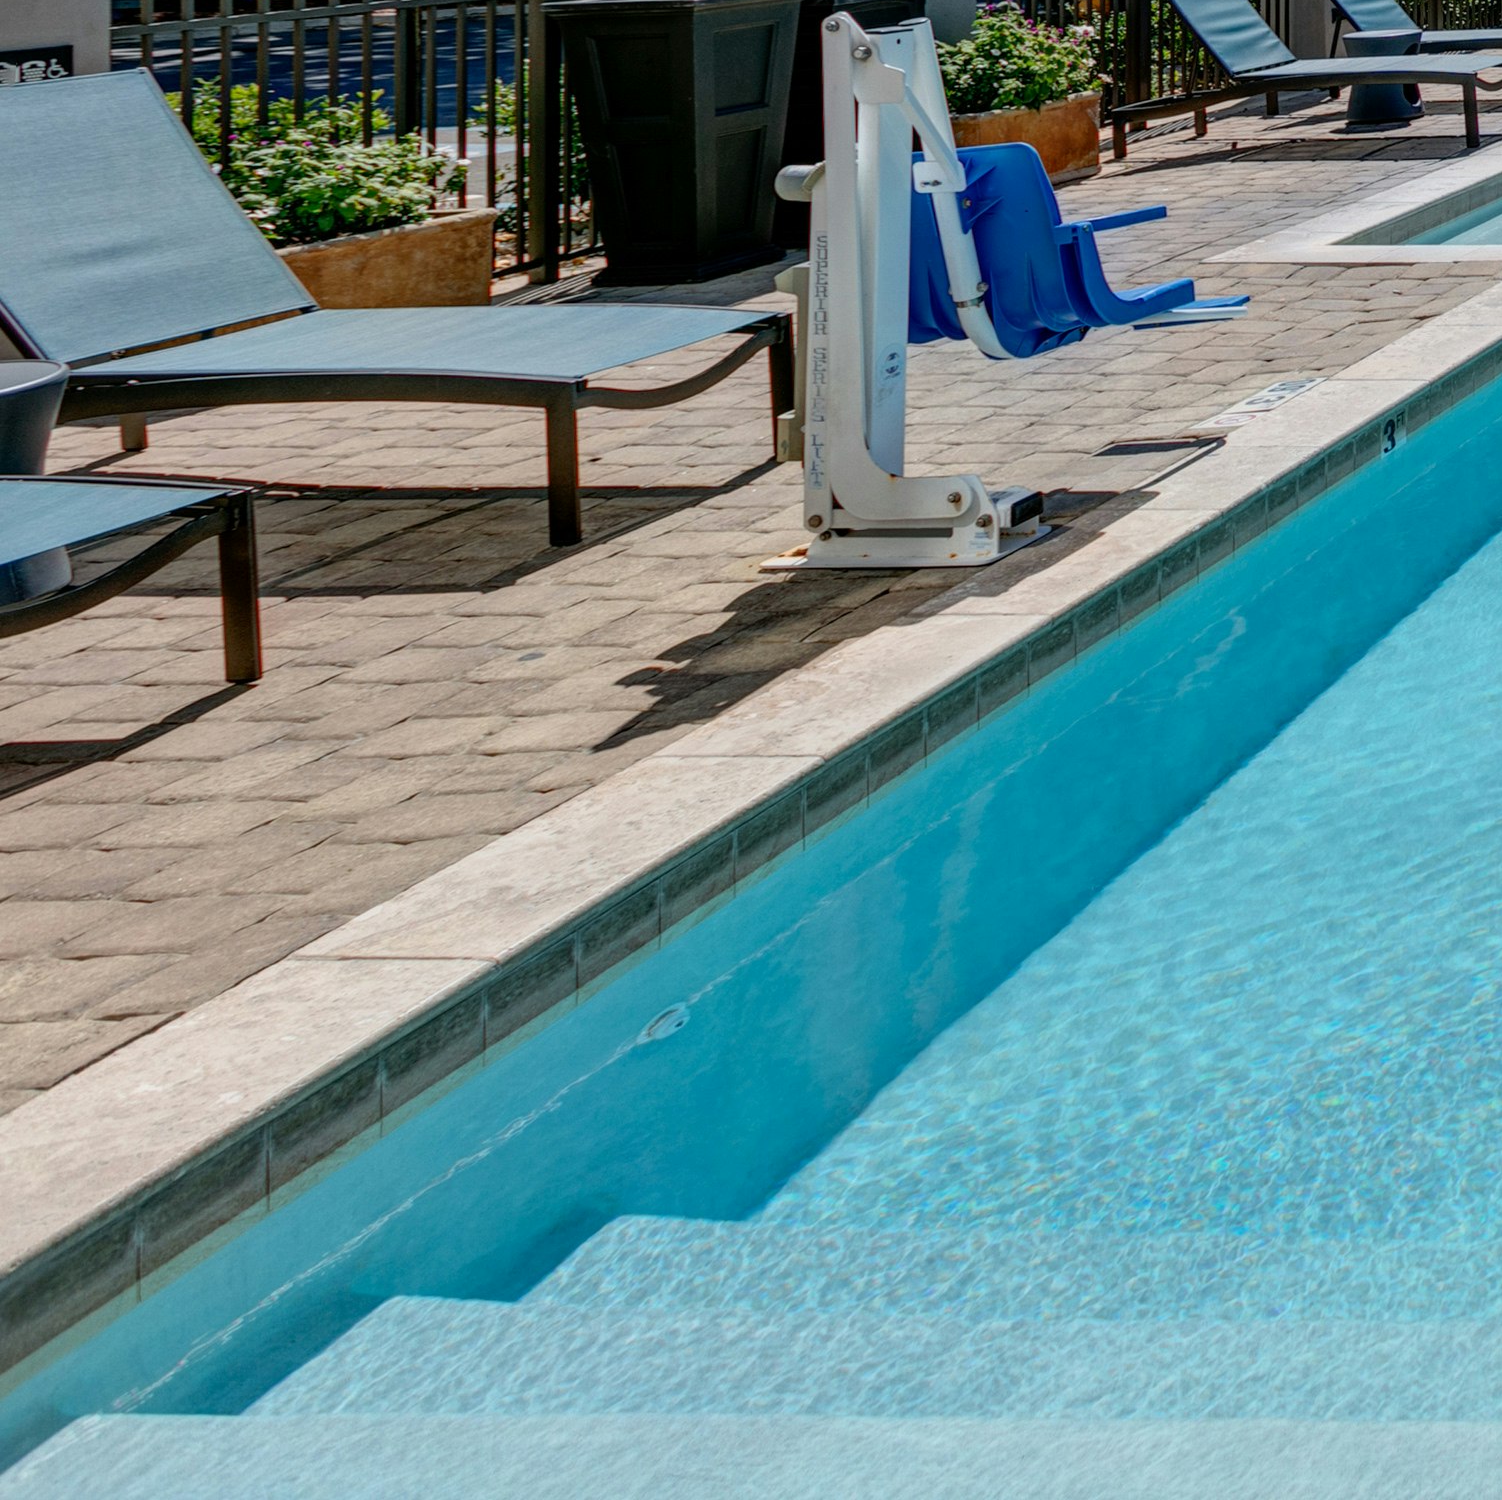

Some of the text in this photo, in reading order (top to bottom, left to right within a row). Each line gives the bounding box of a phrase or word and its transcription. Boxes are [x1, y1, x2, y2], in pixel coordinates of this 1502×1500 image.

[810, 236, 828, 486] SUPERIOR SERIES LIFT
